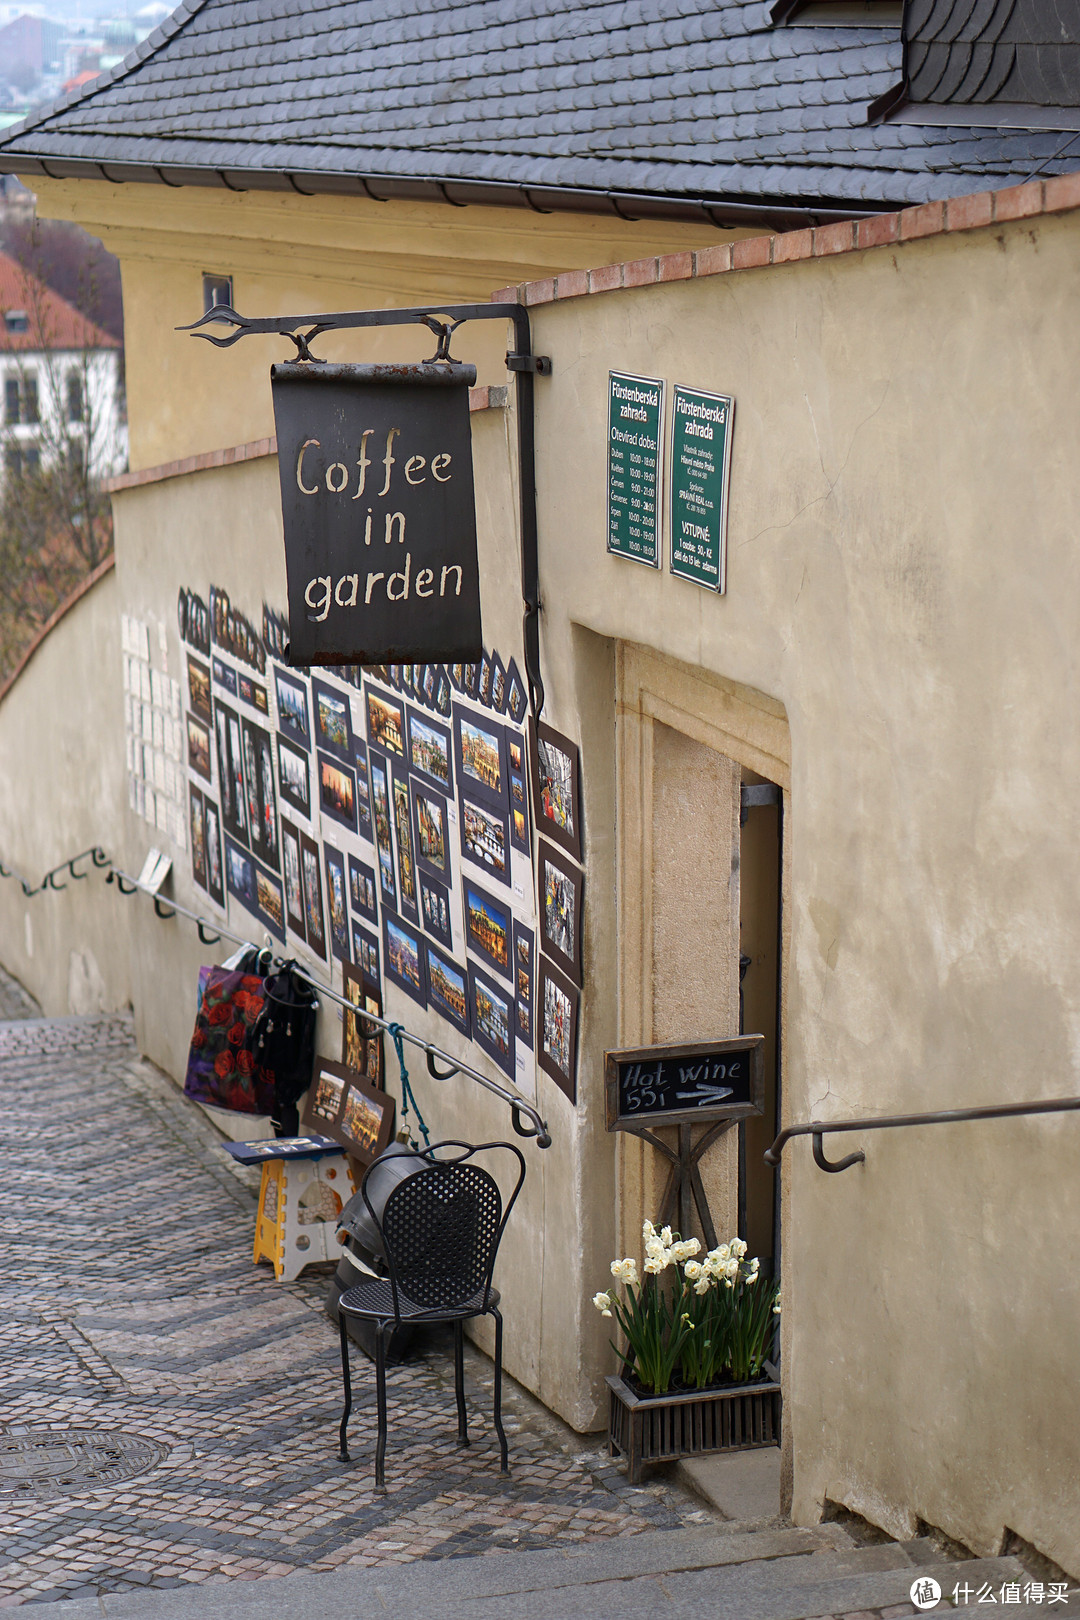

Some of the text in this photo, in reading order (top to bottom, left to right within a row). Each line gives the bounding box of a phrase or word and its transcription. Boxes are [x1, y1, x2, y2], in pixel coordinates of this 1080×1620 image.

[612, 382, 658, 406] Fürstenberská
[620, 403, 647, 422] zahrada
[677, 397, 725, 424] Fürstenberská
[611, 426, 656, 450] Otevírací doba:
[685, 419, 713, 440] zahrada
[296, 428, 452, 500] Coffee
[364, 508, 406, 546] in
[682, 521, 710, 542] VSTUPNÉ:
[682, 553, 688, 563] do
[688, 555, 693, 565] 15
[304, 552, 462, 622] garden
[623, 1058, 741, 1088] Hot wine
